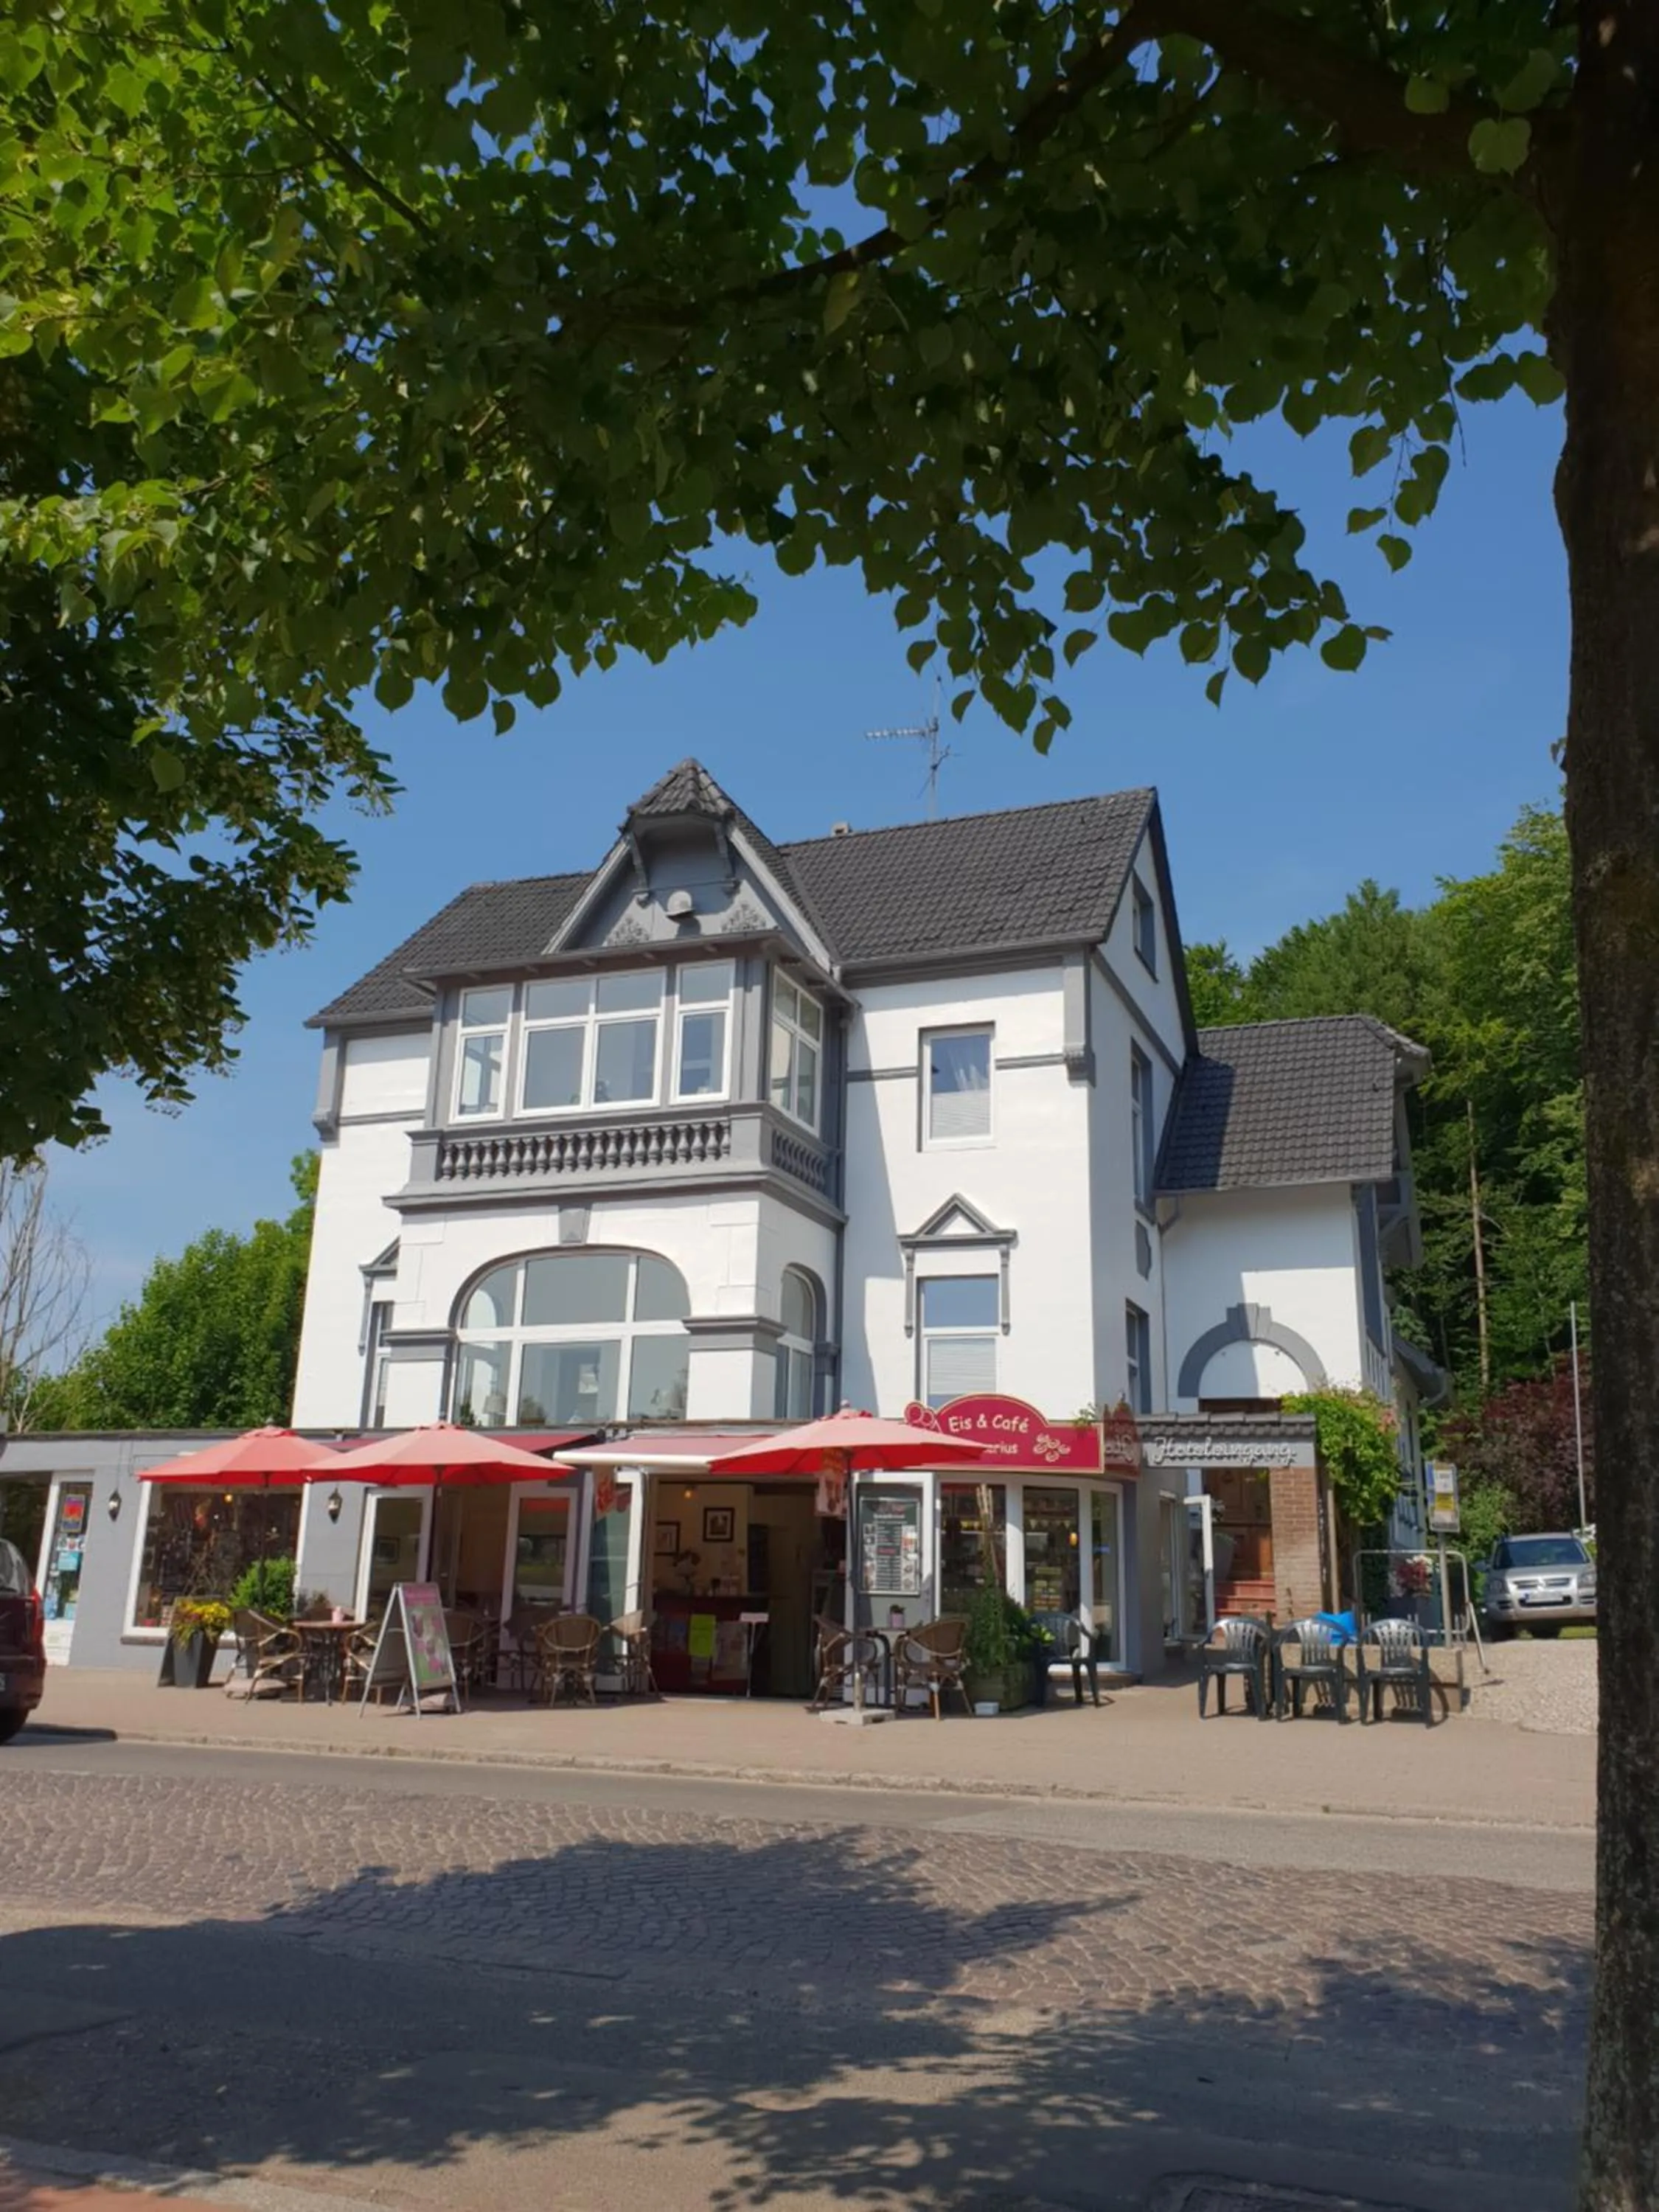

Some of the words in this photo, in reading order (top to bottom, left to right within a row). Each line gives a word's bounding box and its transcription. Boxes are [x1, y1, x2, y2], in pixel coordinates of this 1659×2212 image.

[948, 1416, 972, 1432] Eis
[976, 1413, 987, 1428] &
[992, 1414, 1029, 1433] Café
